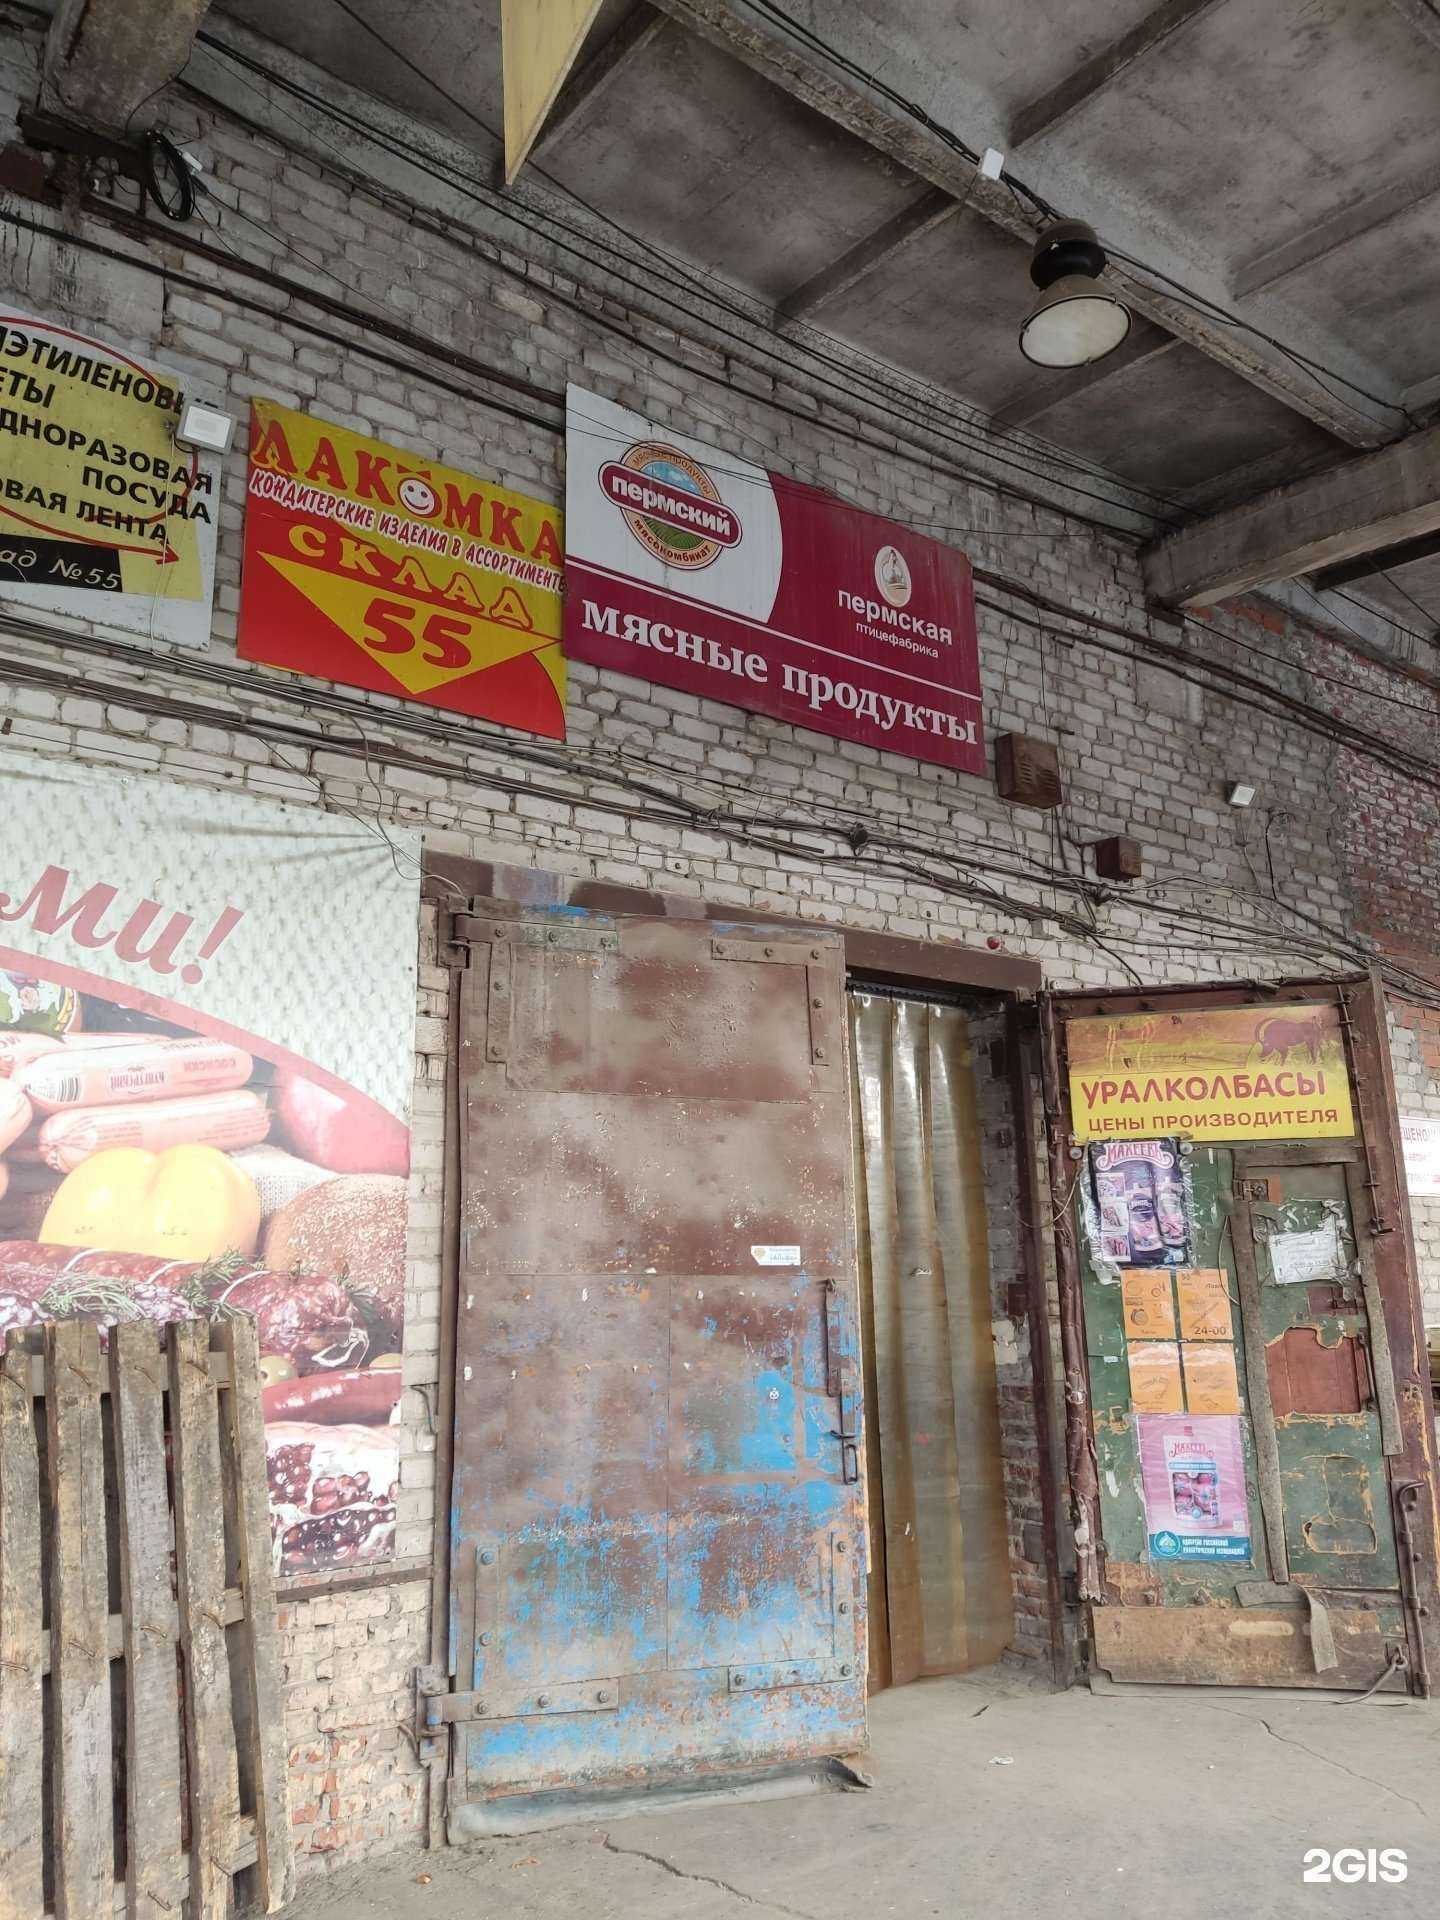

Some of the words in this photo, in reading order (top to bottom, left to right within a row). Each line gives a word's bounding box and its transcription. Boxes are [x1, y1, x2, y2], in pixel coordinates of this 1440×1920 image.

[0, 326, 219, 414] ЭТИЛЕНОВ
[0, 477, 66, 513] ВАЯ
[77, 501, 170, 546] ЛЕНТА
[82, 466, 211, 524] ПОСУДА
[251, 419, 563, 567] ЛАКОМКА
[612, 475, 731, 536] пермский
[250, 469, 374, 528] КОНДИТЕРСКИЕ
[379, 514, 447, 552] ИЗДЕЛИЯ
[451, 542, 460, 557] В
[465, 545, 567, 592] АССОРТИМЕНТЕ
[288, 525, 532, 630] СКЛАД
[363, 598, 472, 669] 55
[838, 590, 952, 646] пермская
[856, 622, 939, 658] птицефабрика
[582, 600, 768, 683] мясные
[782, 664, 978, 744] продукты
[1081, 1070, 1326, 1109] УРАЛКОЛБАСЫ
[1088, 1116, 1145, 1133] ЦЕНЫ
[1153, 1108, 1338, 1129] ПРОИЗВОДИТЕЛЯ
